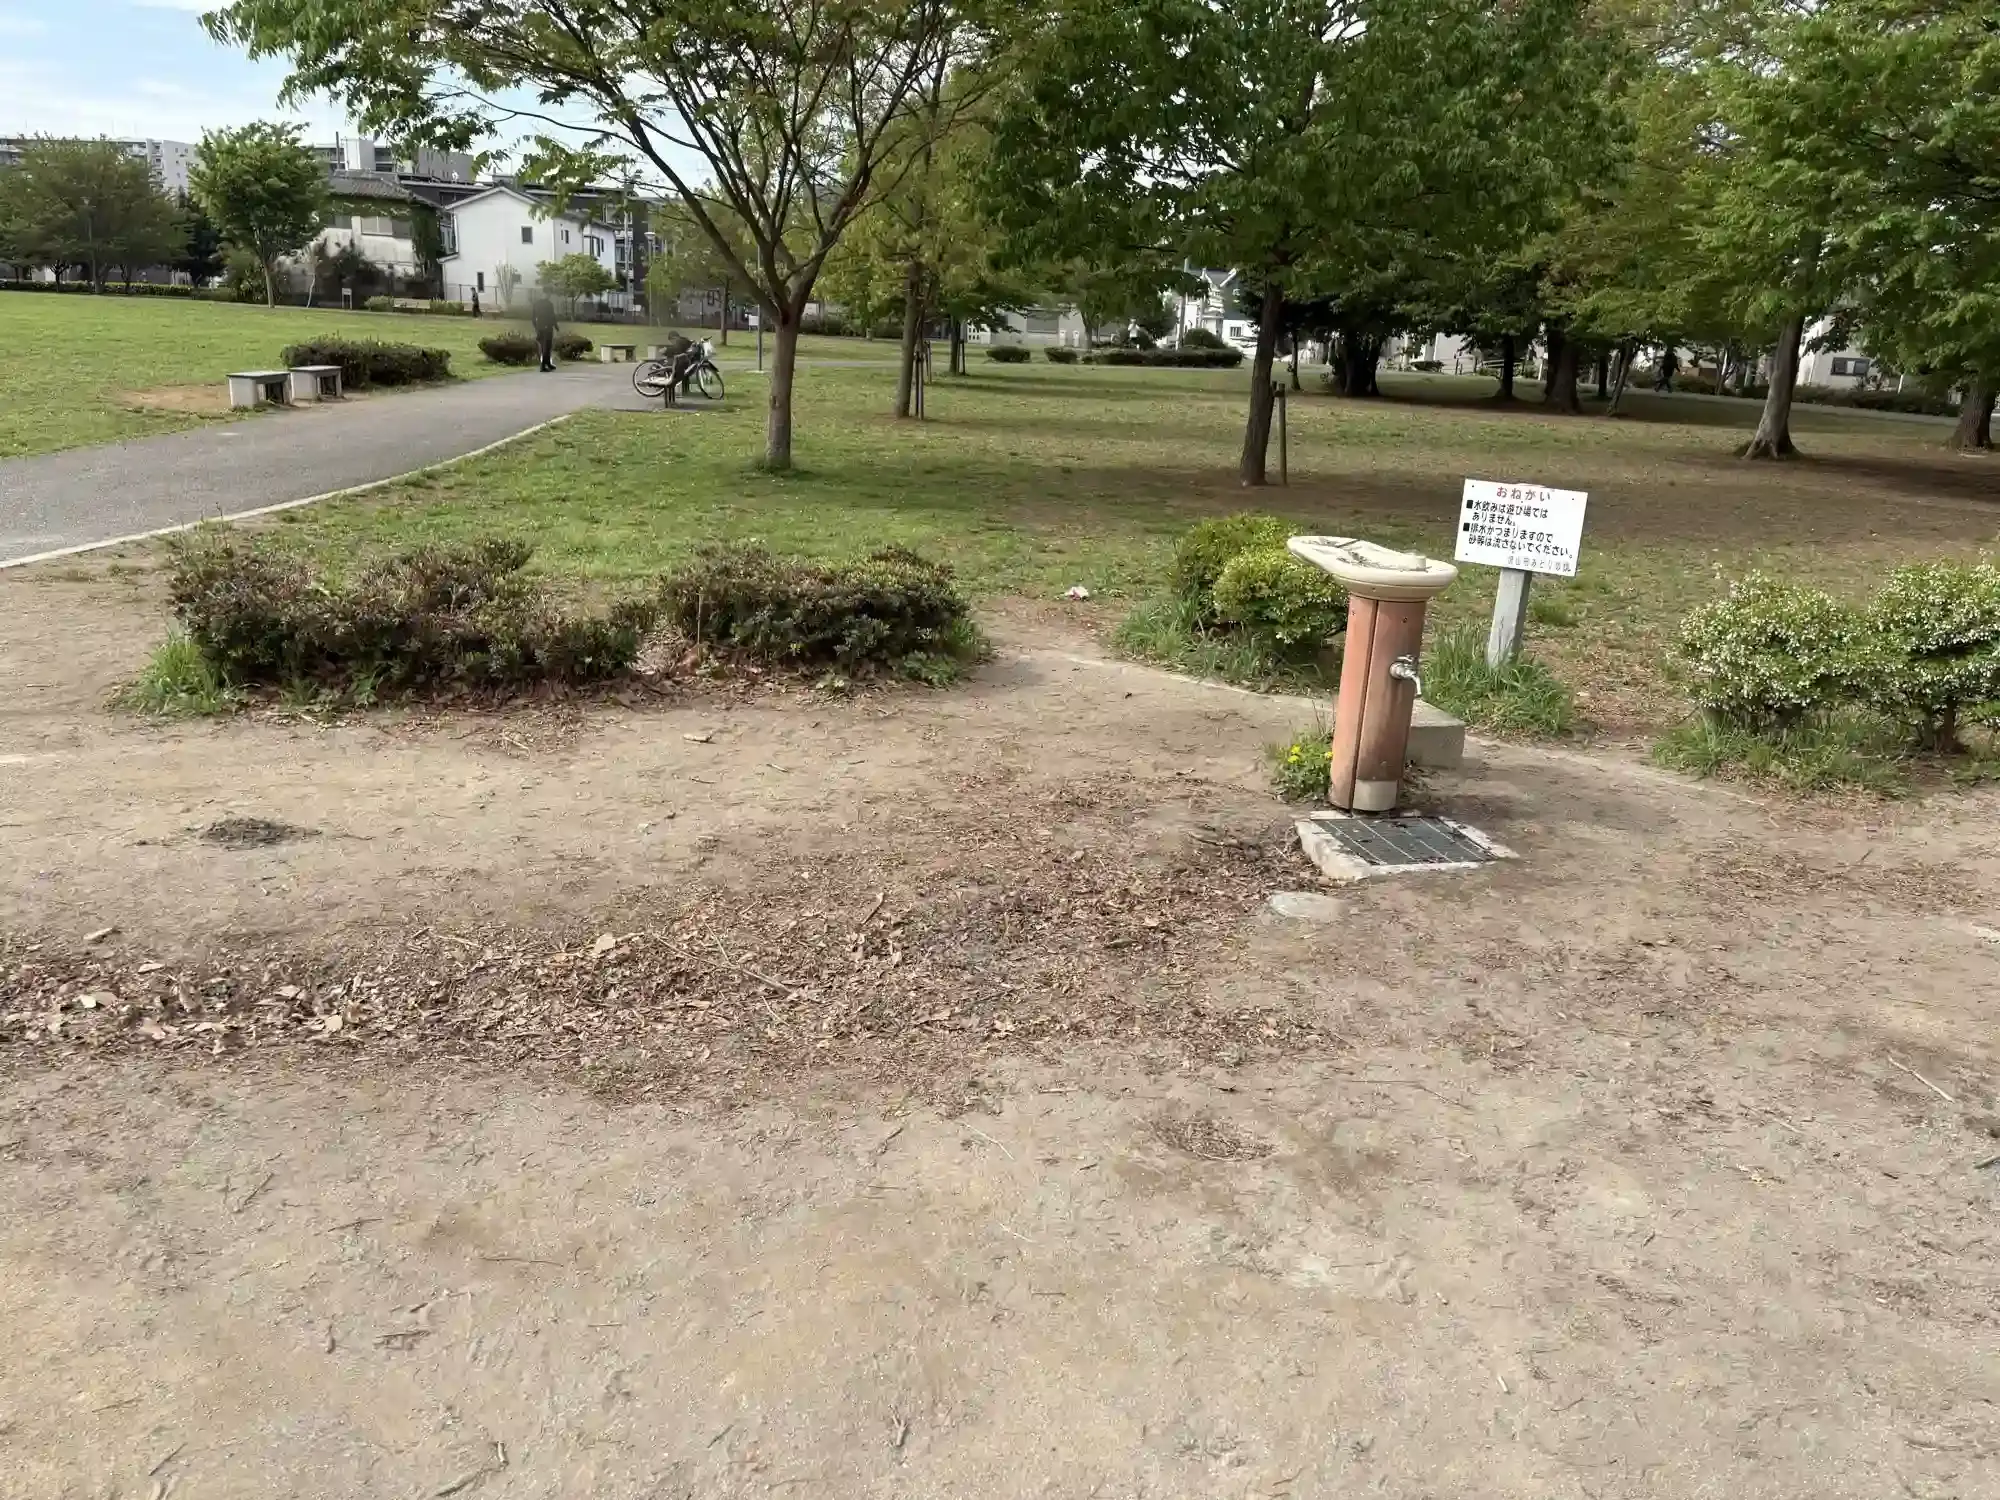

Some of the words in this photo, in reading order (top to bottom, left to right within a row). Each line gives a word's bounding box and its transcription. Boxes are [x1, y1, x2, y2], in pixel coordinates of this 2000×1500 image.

[1497, 487, 1551, 501] おねがい
[1472, 512, 1516, 526] ありません。
